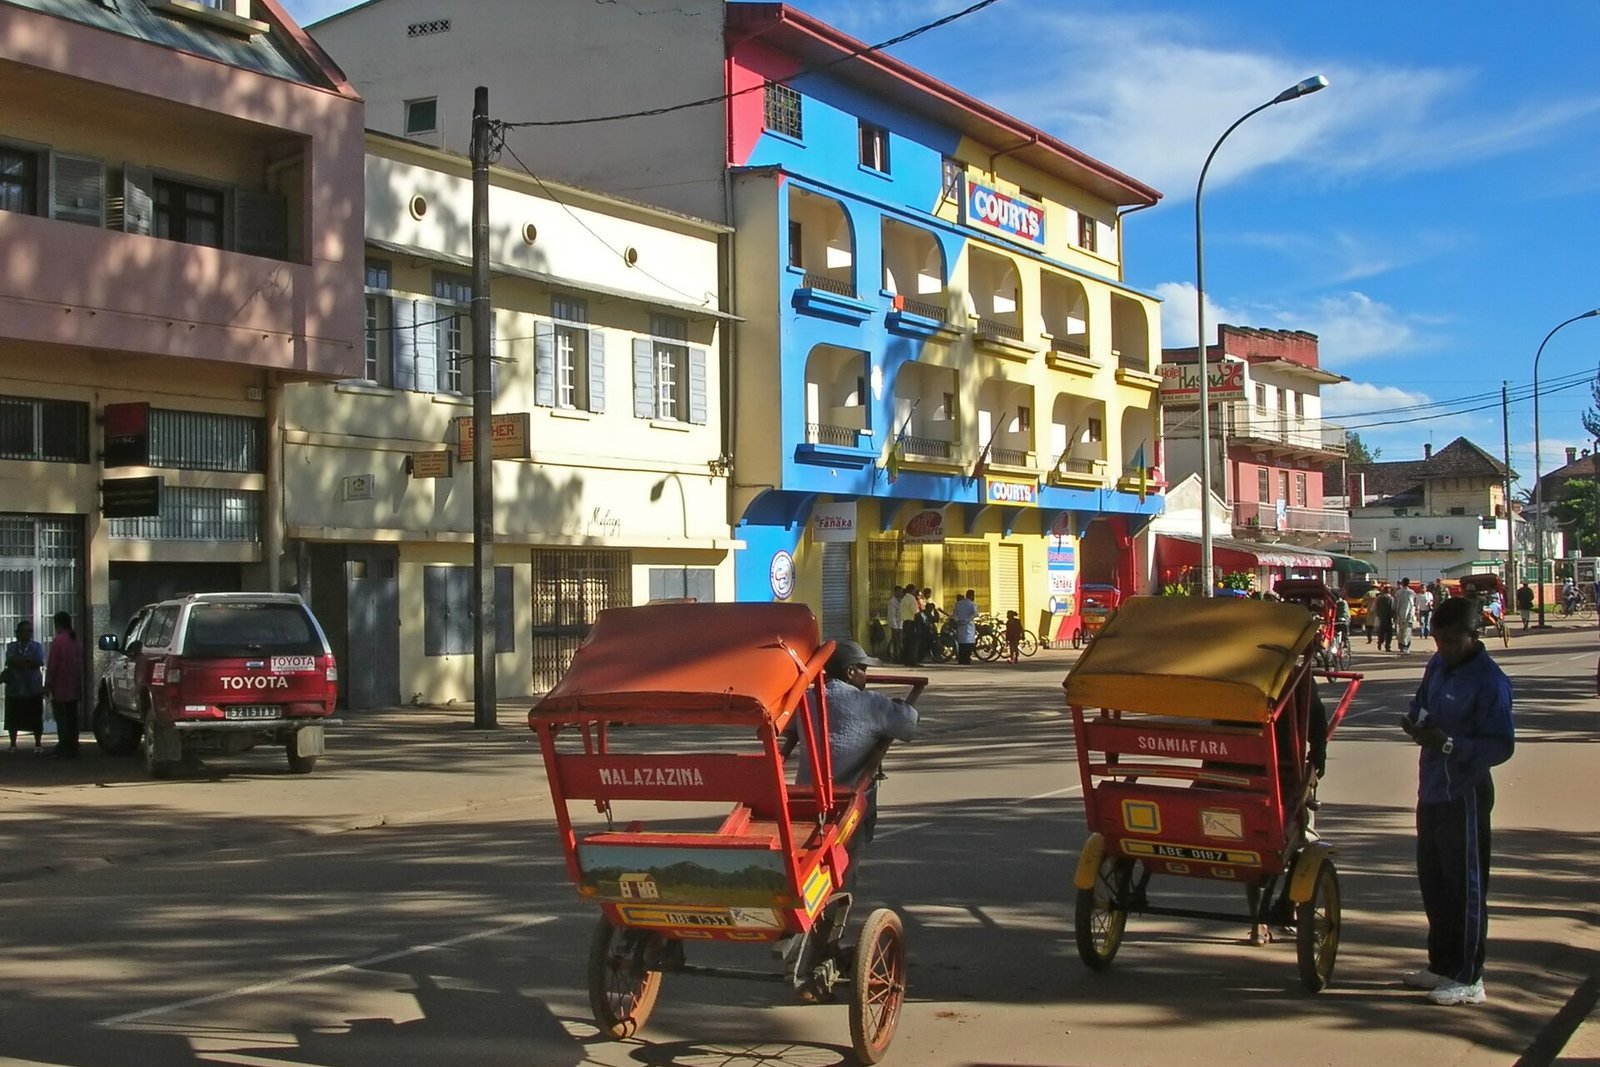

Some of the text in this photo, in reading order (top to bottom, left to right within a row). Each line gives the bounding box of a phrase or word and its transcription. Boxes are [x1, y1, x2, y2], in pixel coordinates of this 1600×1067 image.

[974, 190, 1040, 237] COURTS
[993, 482, 1031, 502] COURTS
[819, 516, 852, 528] Fanaka
[272, 656, 314, 666] TOYOTA
[220, 676, 288, 689] TOYOTA
[1138, 736, 1228, 755] SOAMIAFARA
[599, 768, 704, 786] MALAZAZINA
[1158, 846, 1223, 861] ABE 0187
